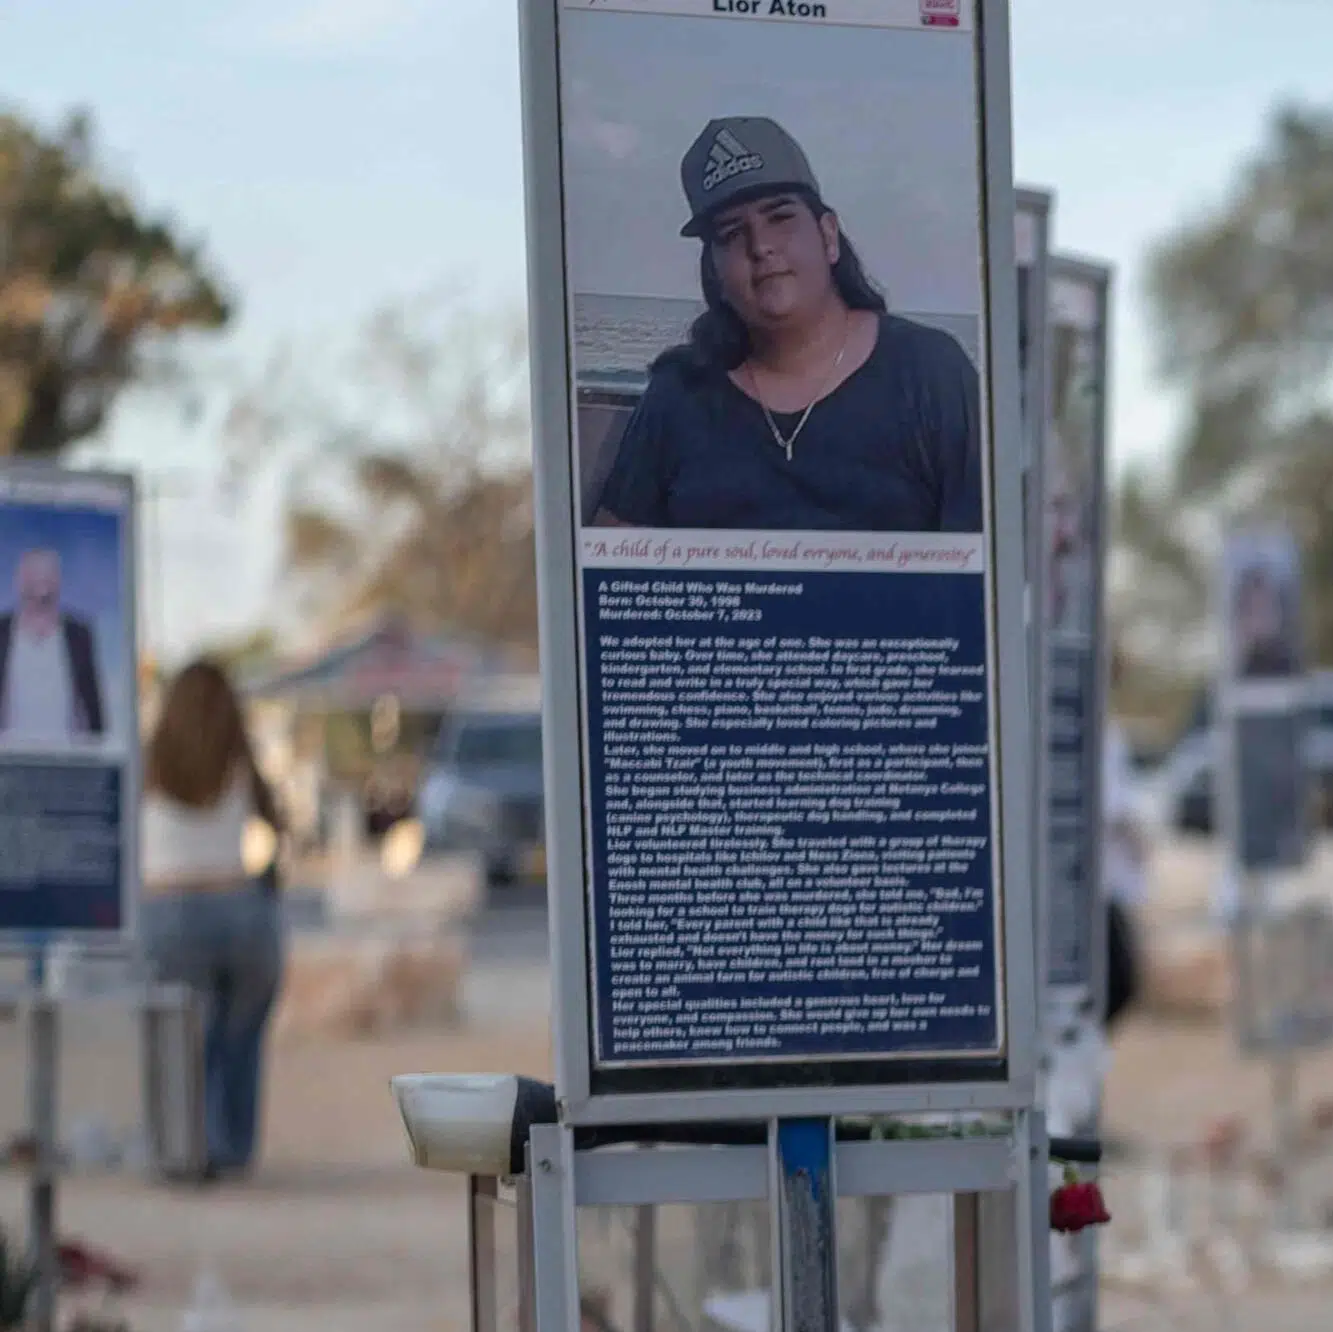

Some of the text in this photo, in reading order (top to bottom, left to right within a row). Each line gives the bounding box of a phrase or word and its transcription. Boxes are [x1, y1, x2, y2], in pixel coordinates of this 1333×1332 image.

[713, 0, 826, 17] Lior Aton
[703, 153, 763, 190] adidas
[612, 538, 651, 558] child
[653, 537, 672, 566] of
[682, 545, 720, 567] pure
[610, 581, 649, 592] Gifted
[651, 582, 684, 593] Child
[686, 582, 713, 593] Who
[715, 582, 742, 593] Was
[744, 583, 803, 594] Murdered
[598, 595, 632, 605] Born:
[635, 595, 685, 606] October
[710, 596, 741, 606] 1998
[599, 608, 662, 619] Murdered:
[664, 609, 714, 620] October
[731, 609, 762, 620] 2023
